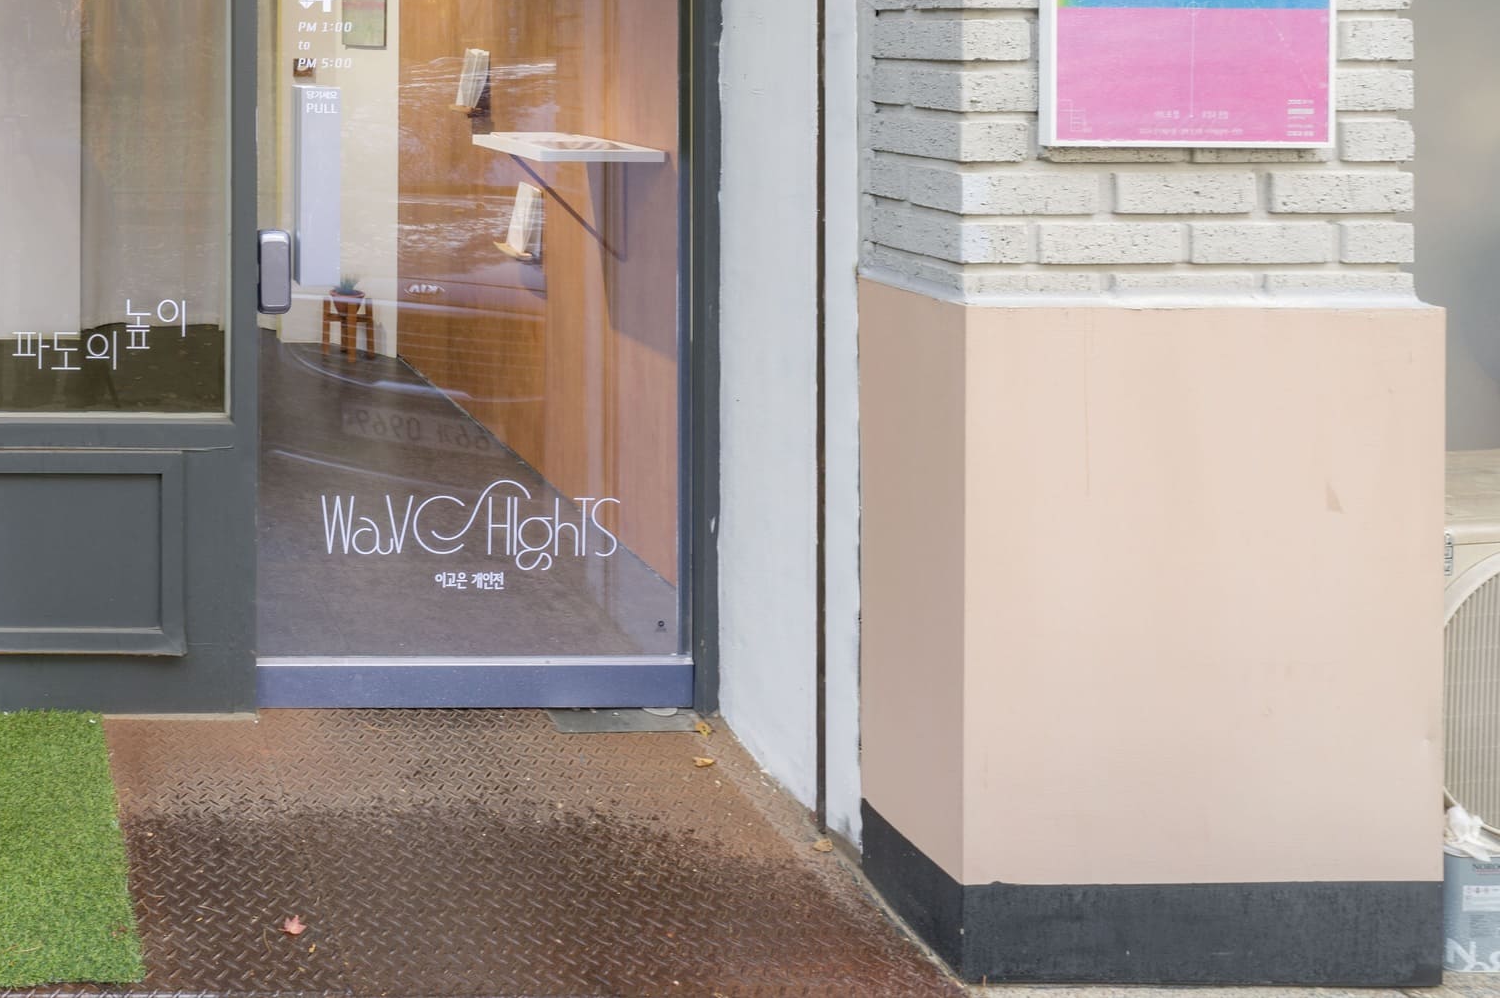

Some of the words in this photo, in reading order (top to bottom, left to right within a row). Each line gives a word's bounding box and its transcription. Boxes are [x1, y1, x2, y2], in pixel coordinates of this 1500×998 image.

[298, 21, 317, 32] PM
[321, 21, 353, 33] 1:00
[298, 41, 311, 51] to
[297, 57, 317, 69] PM
[321, 57, 353, 69] 5:00
[306, 103, 339, 114] PULL
[12, 330, 117, 370] 파도의
[126, 299, 186, 350] 높이
[434, 571, 469, 590] 이고은
[471, 571, 505, 590] 개인전
